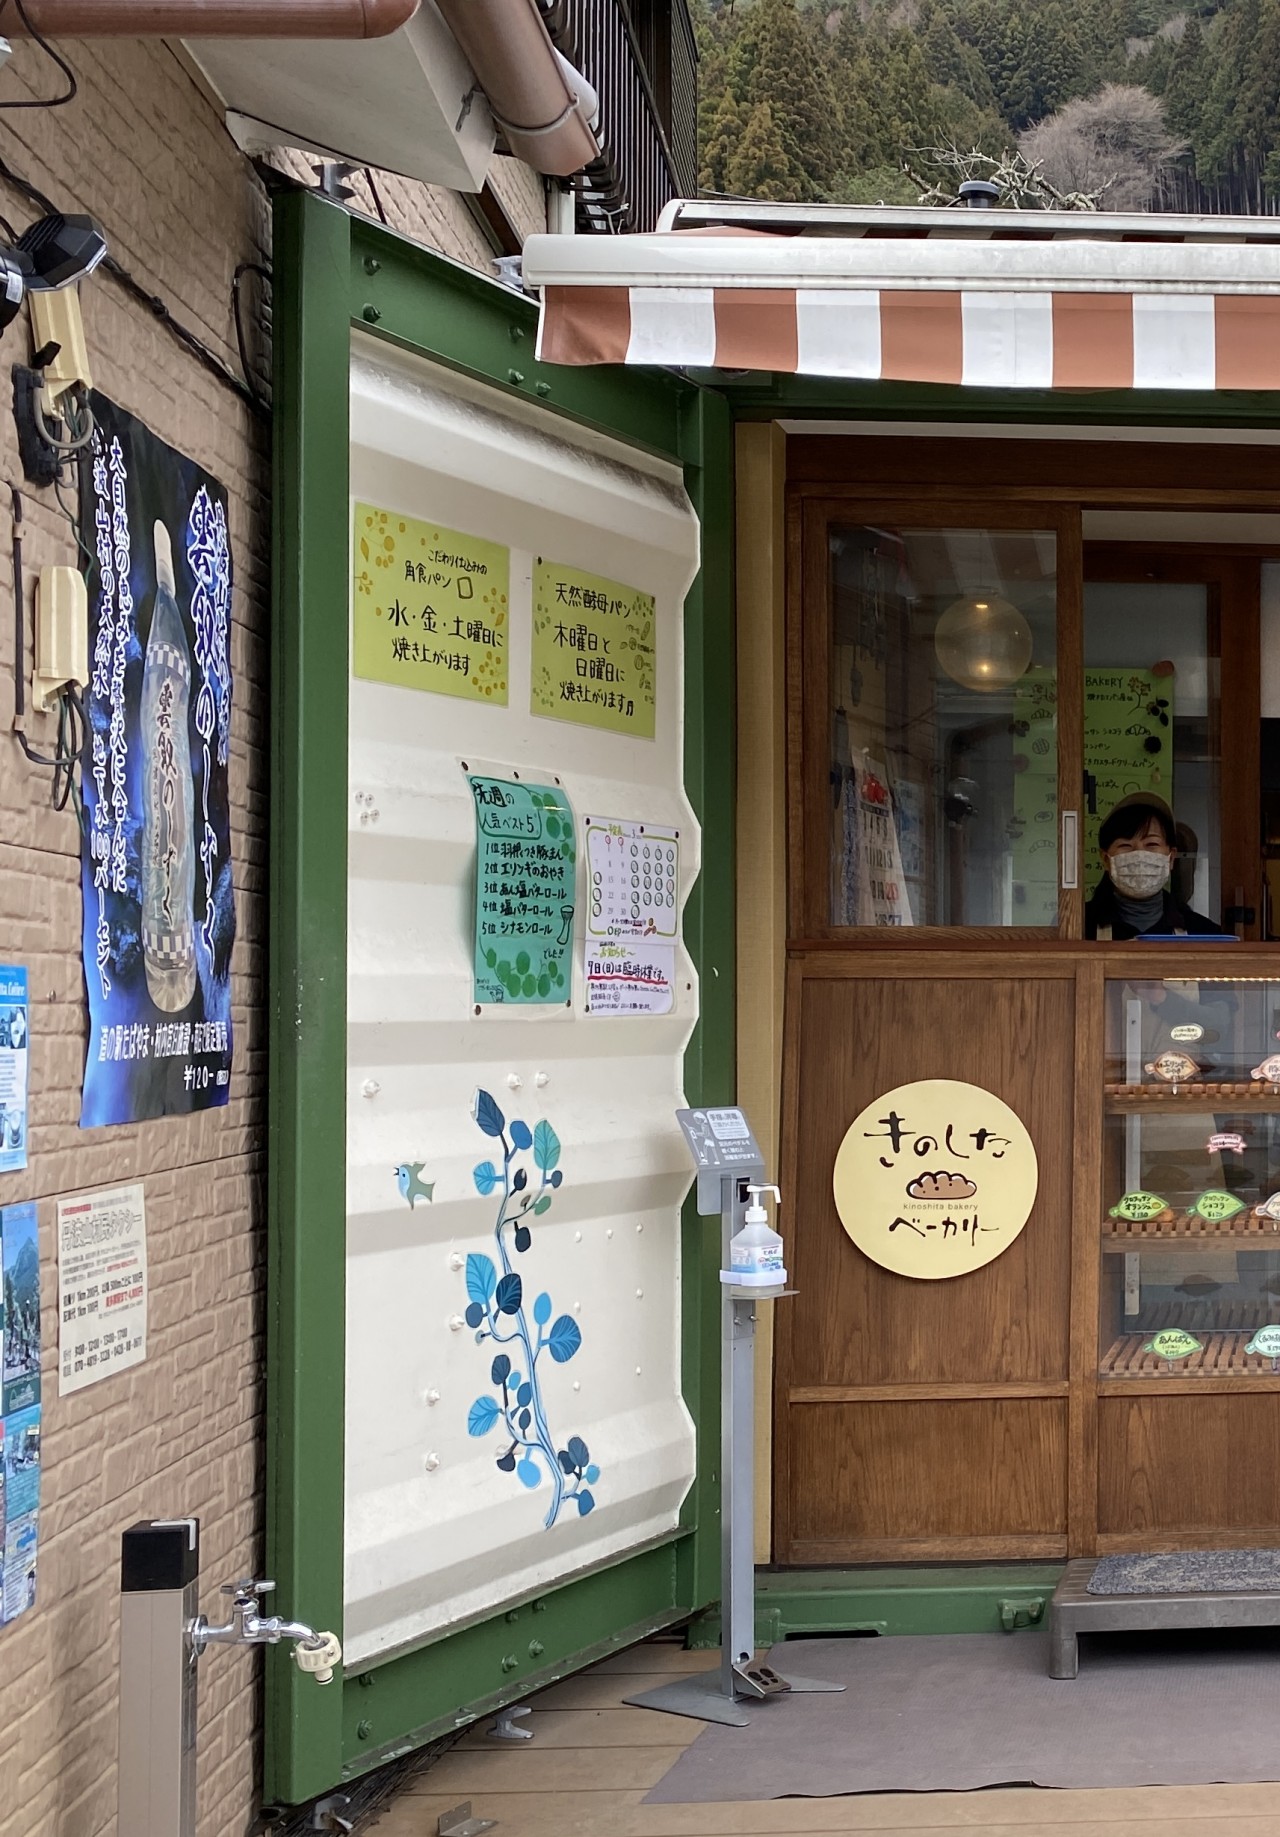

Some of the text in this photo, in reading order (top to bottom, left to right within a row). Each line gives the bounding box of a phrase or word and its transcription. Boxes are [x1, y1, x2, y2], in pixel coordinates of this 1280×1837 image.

[555, 582, 632, 619] 天然酵母パン
[387, 599, 503, 648] 水・金・土曜日に
[553, 621, 611, 654] 木曜日と
[391, 637, 471, 676] 焼き上がります
[575, 658, 625, 683] 日曜日に
[559, 681, 626, 715] 焼き上がります
[472, 783, 515, 808] 先週の
[484, 863, 499, 874] 2位
[483, 881, 497, 894] 3位
[482, 900, 497, 913] 4位
[481, 920, 552, 935] 5位 シナモンロール
[863, 1110, 1012, 1168] きのした
[948, 1203, 979, 1212] bakery
[889, 1214, 1000, 1246] ベーカリー
